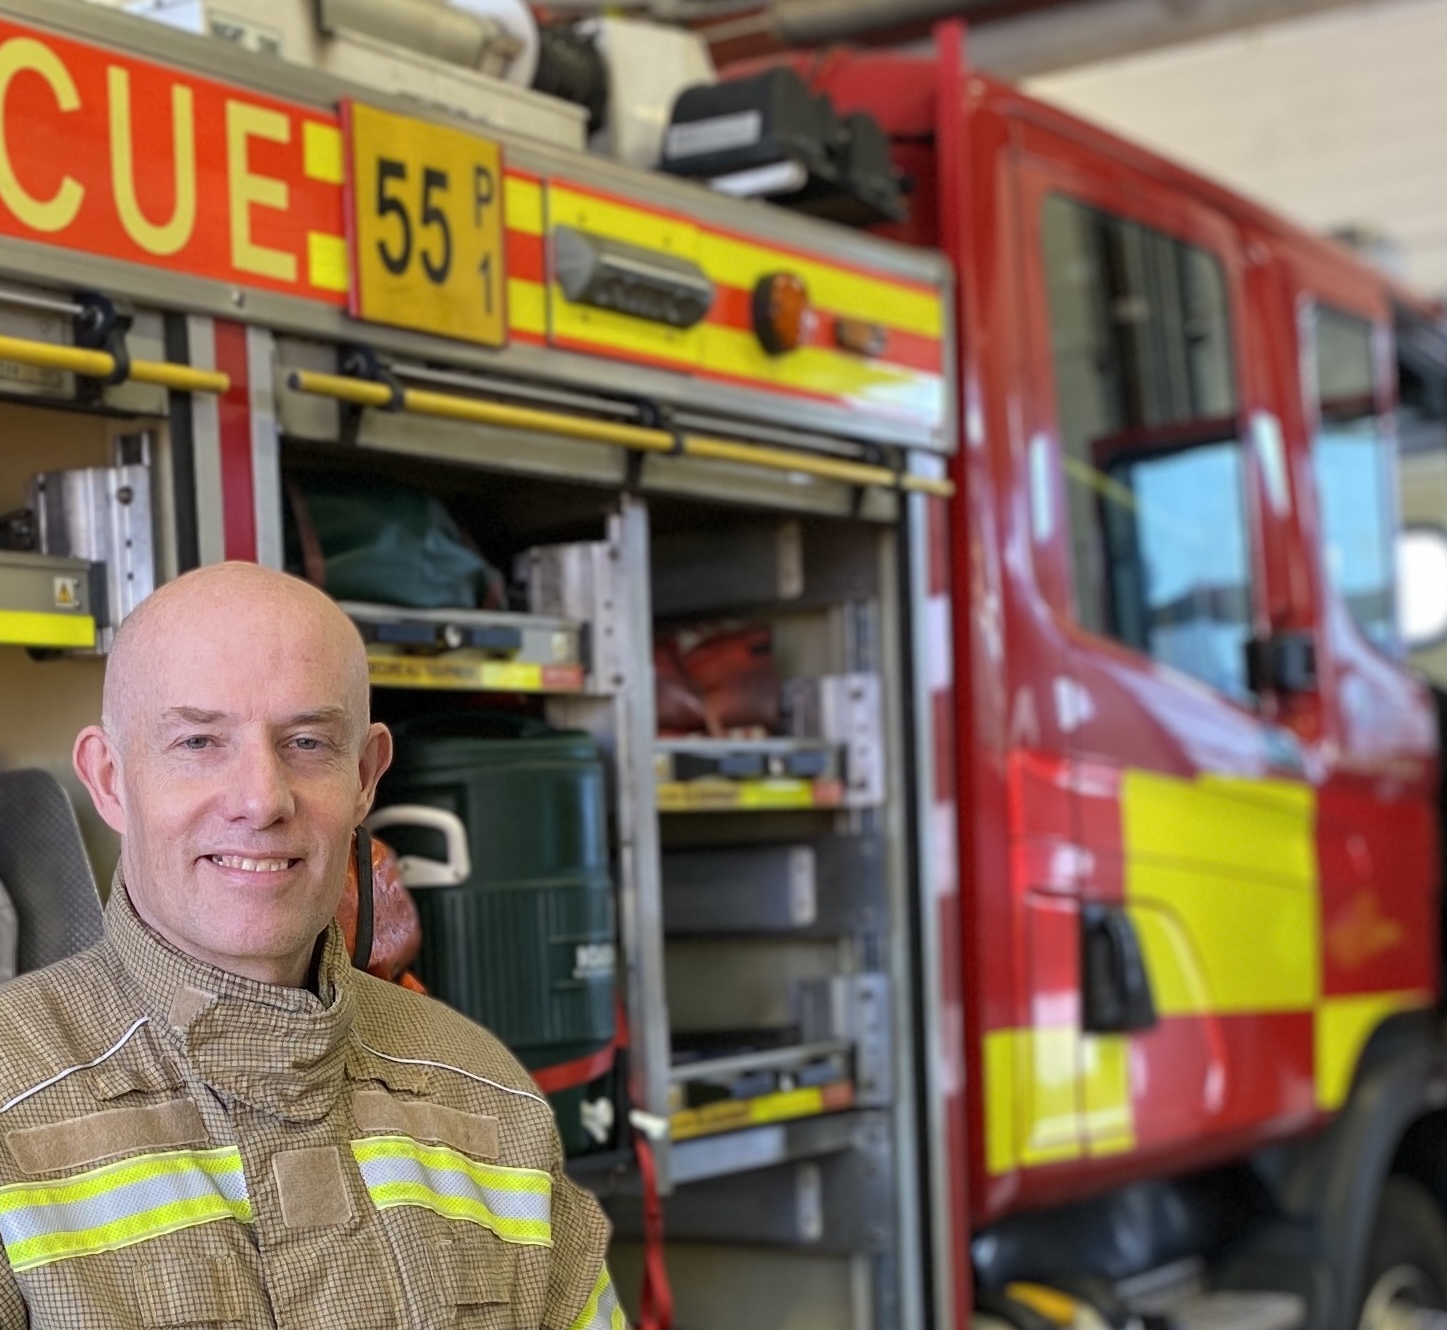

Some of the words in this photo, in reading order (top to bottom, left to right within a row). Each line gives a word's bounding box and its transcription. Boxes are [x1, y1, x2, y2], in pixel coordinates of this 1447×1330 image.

[377, 157, 452, 286] 55
[473, 163, 494, 231] P
[478, 252, 492, 316] 1
